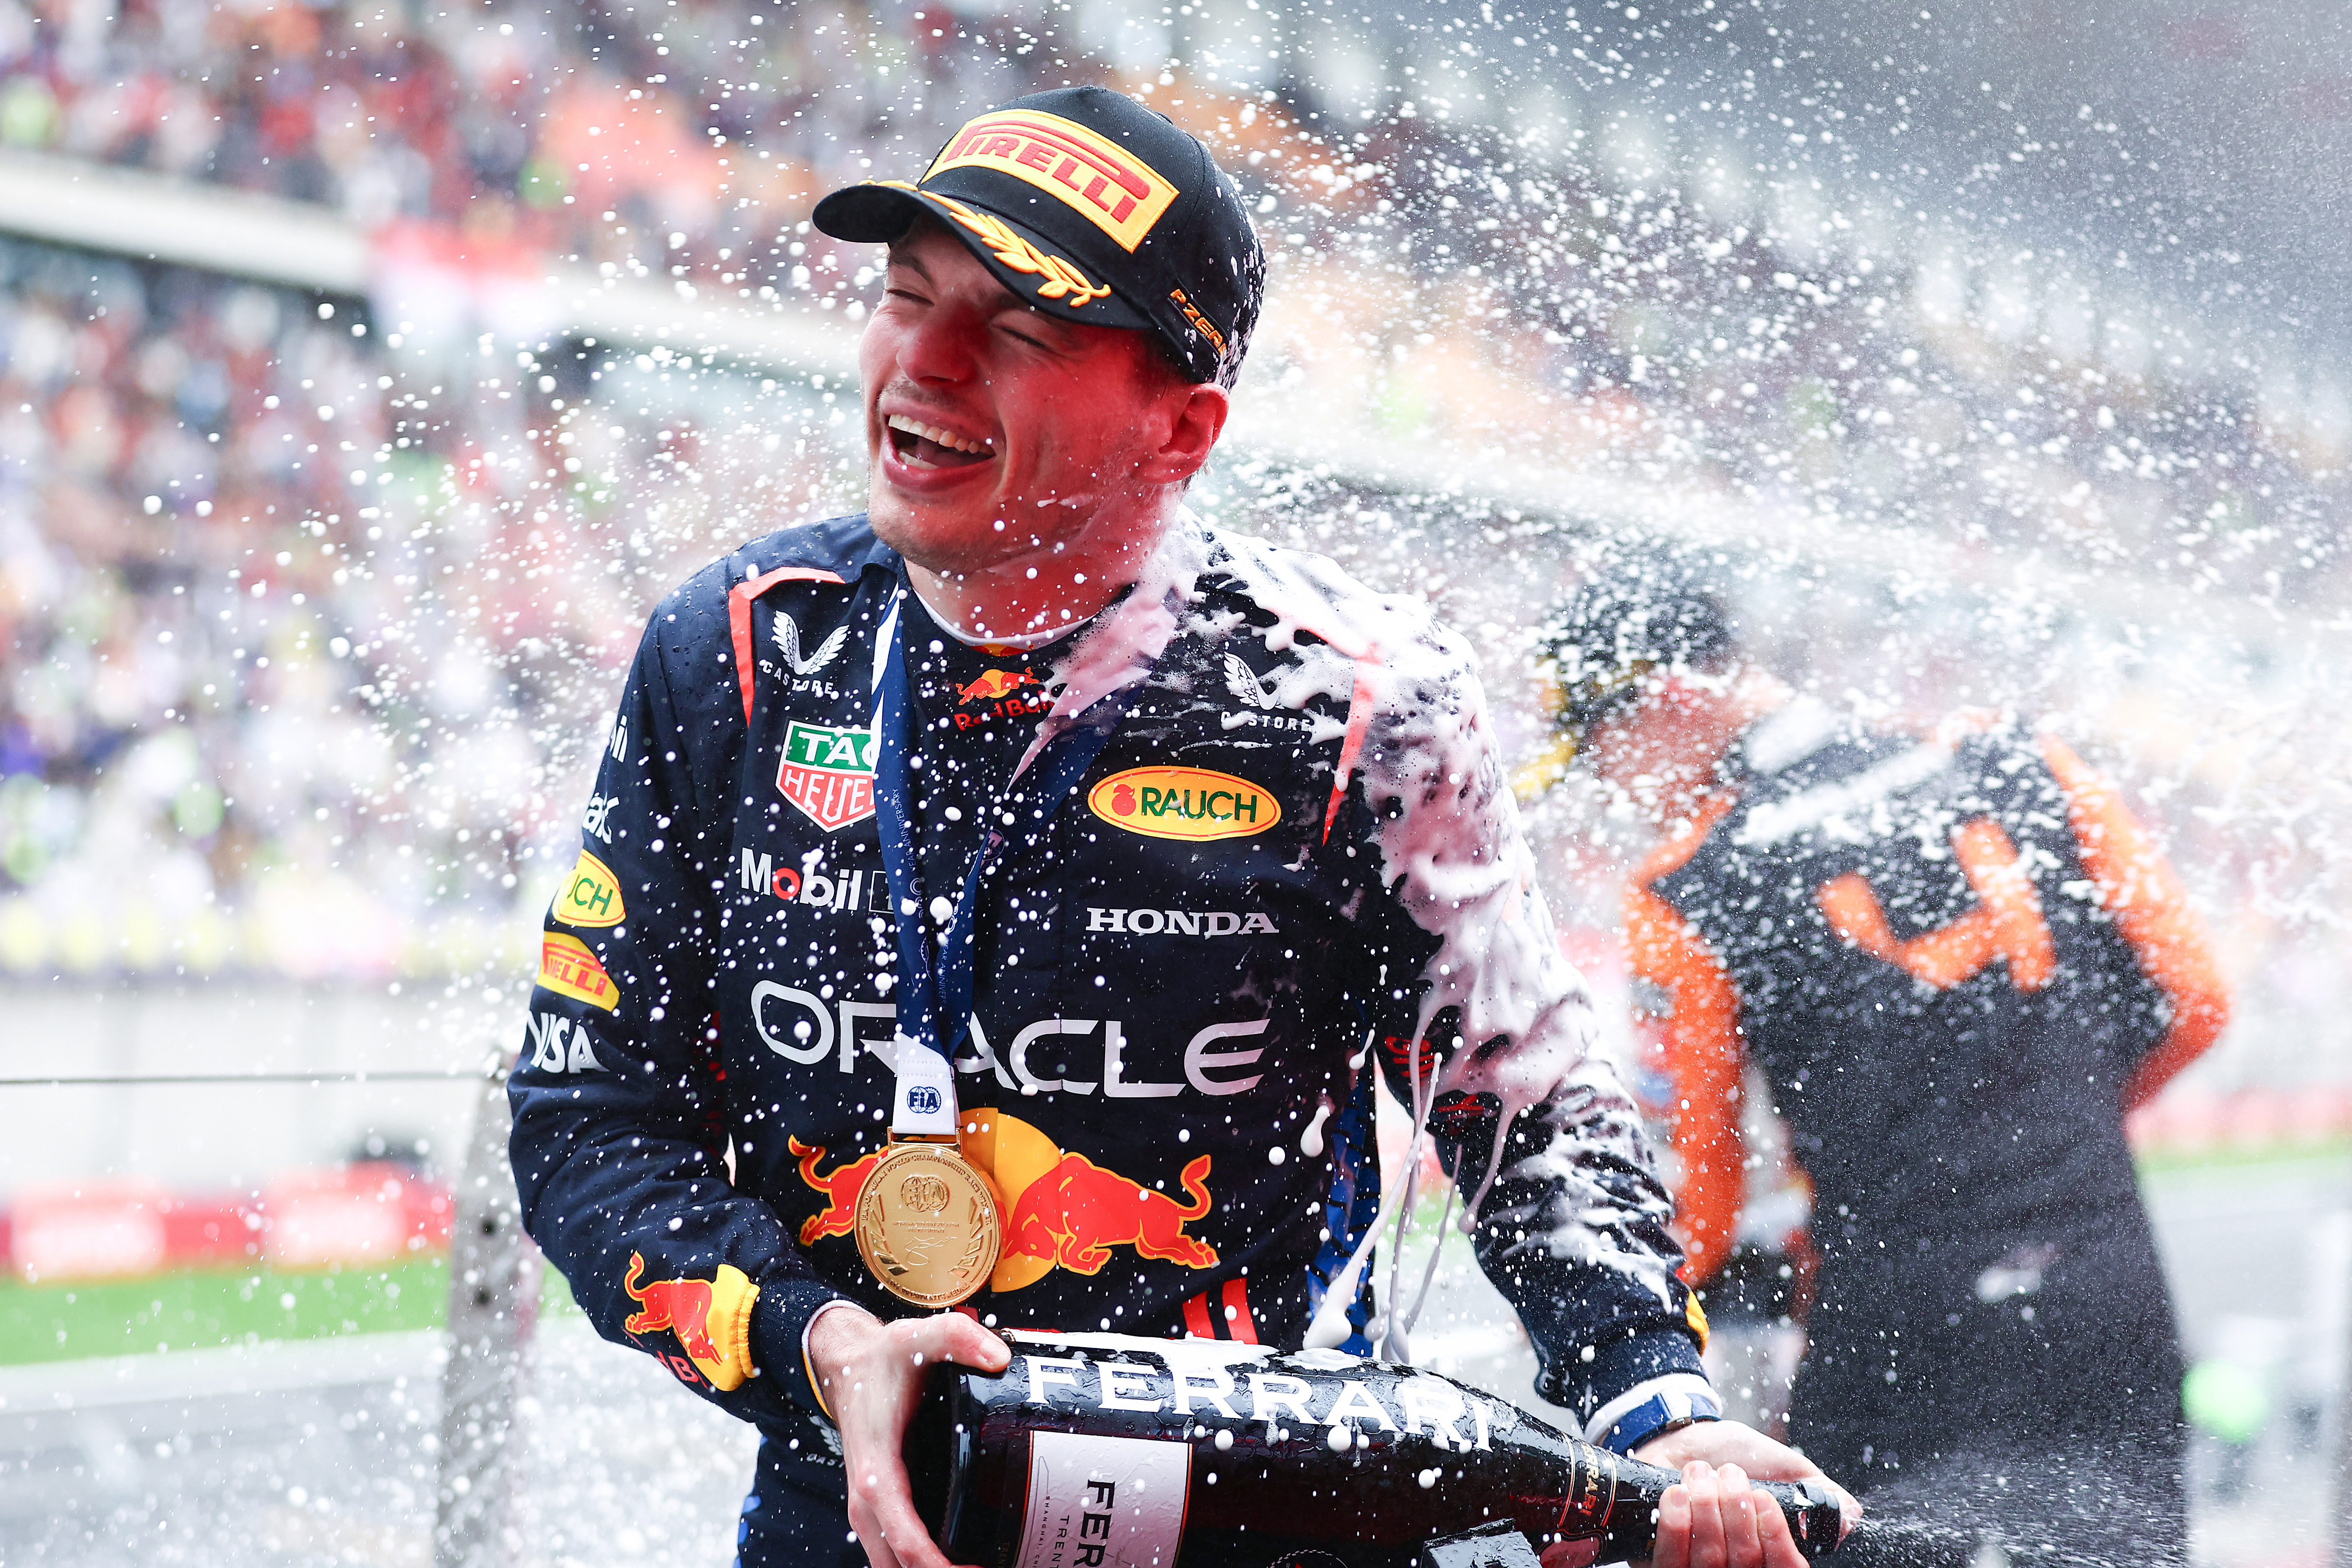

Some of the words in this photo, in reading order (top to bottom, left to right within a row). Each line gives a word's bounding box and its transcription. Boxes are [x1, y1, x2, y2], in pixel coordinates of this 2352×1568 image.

[944, 120, 1151, 223] PIRELLI
[763, 661, 833, 695] CASTORE
[784, 769, 875, 823] HEUE
[892, 788, 912, 847] ANNIVERSARY
[1142, 787, 1257, 823] RAUCH
[741, 847, 863, 910] Mobil
[1085, 907, 1279, 935] HONDA
[528, 1010, 610, 1074] VISA
[1019, 1354, 1495, 1453] FERRARI
[1073, 1479, 1115, 1568] FER
